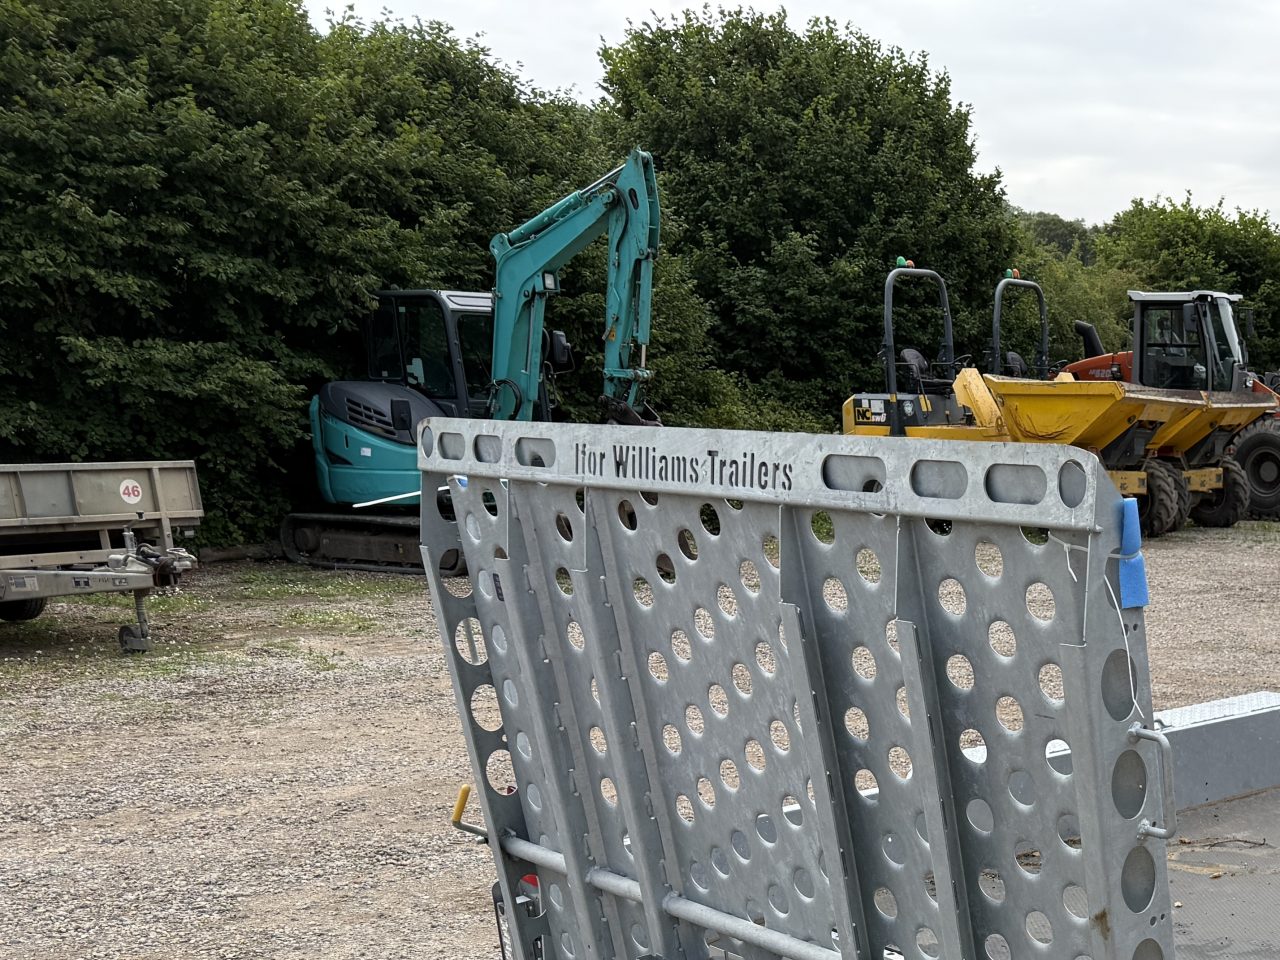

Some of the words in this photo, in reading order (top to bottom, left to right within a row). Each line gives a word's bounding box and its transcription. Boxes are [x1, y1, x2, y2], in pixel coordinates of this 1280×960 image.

[856, 408, 871, 421] NC
[575, 443, 606, 477] Ifor
[612, 445, 699, 483] Williams
[707, 450, 793, 491] Trailers
[122, 485, 141, 498] 46
